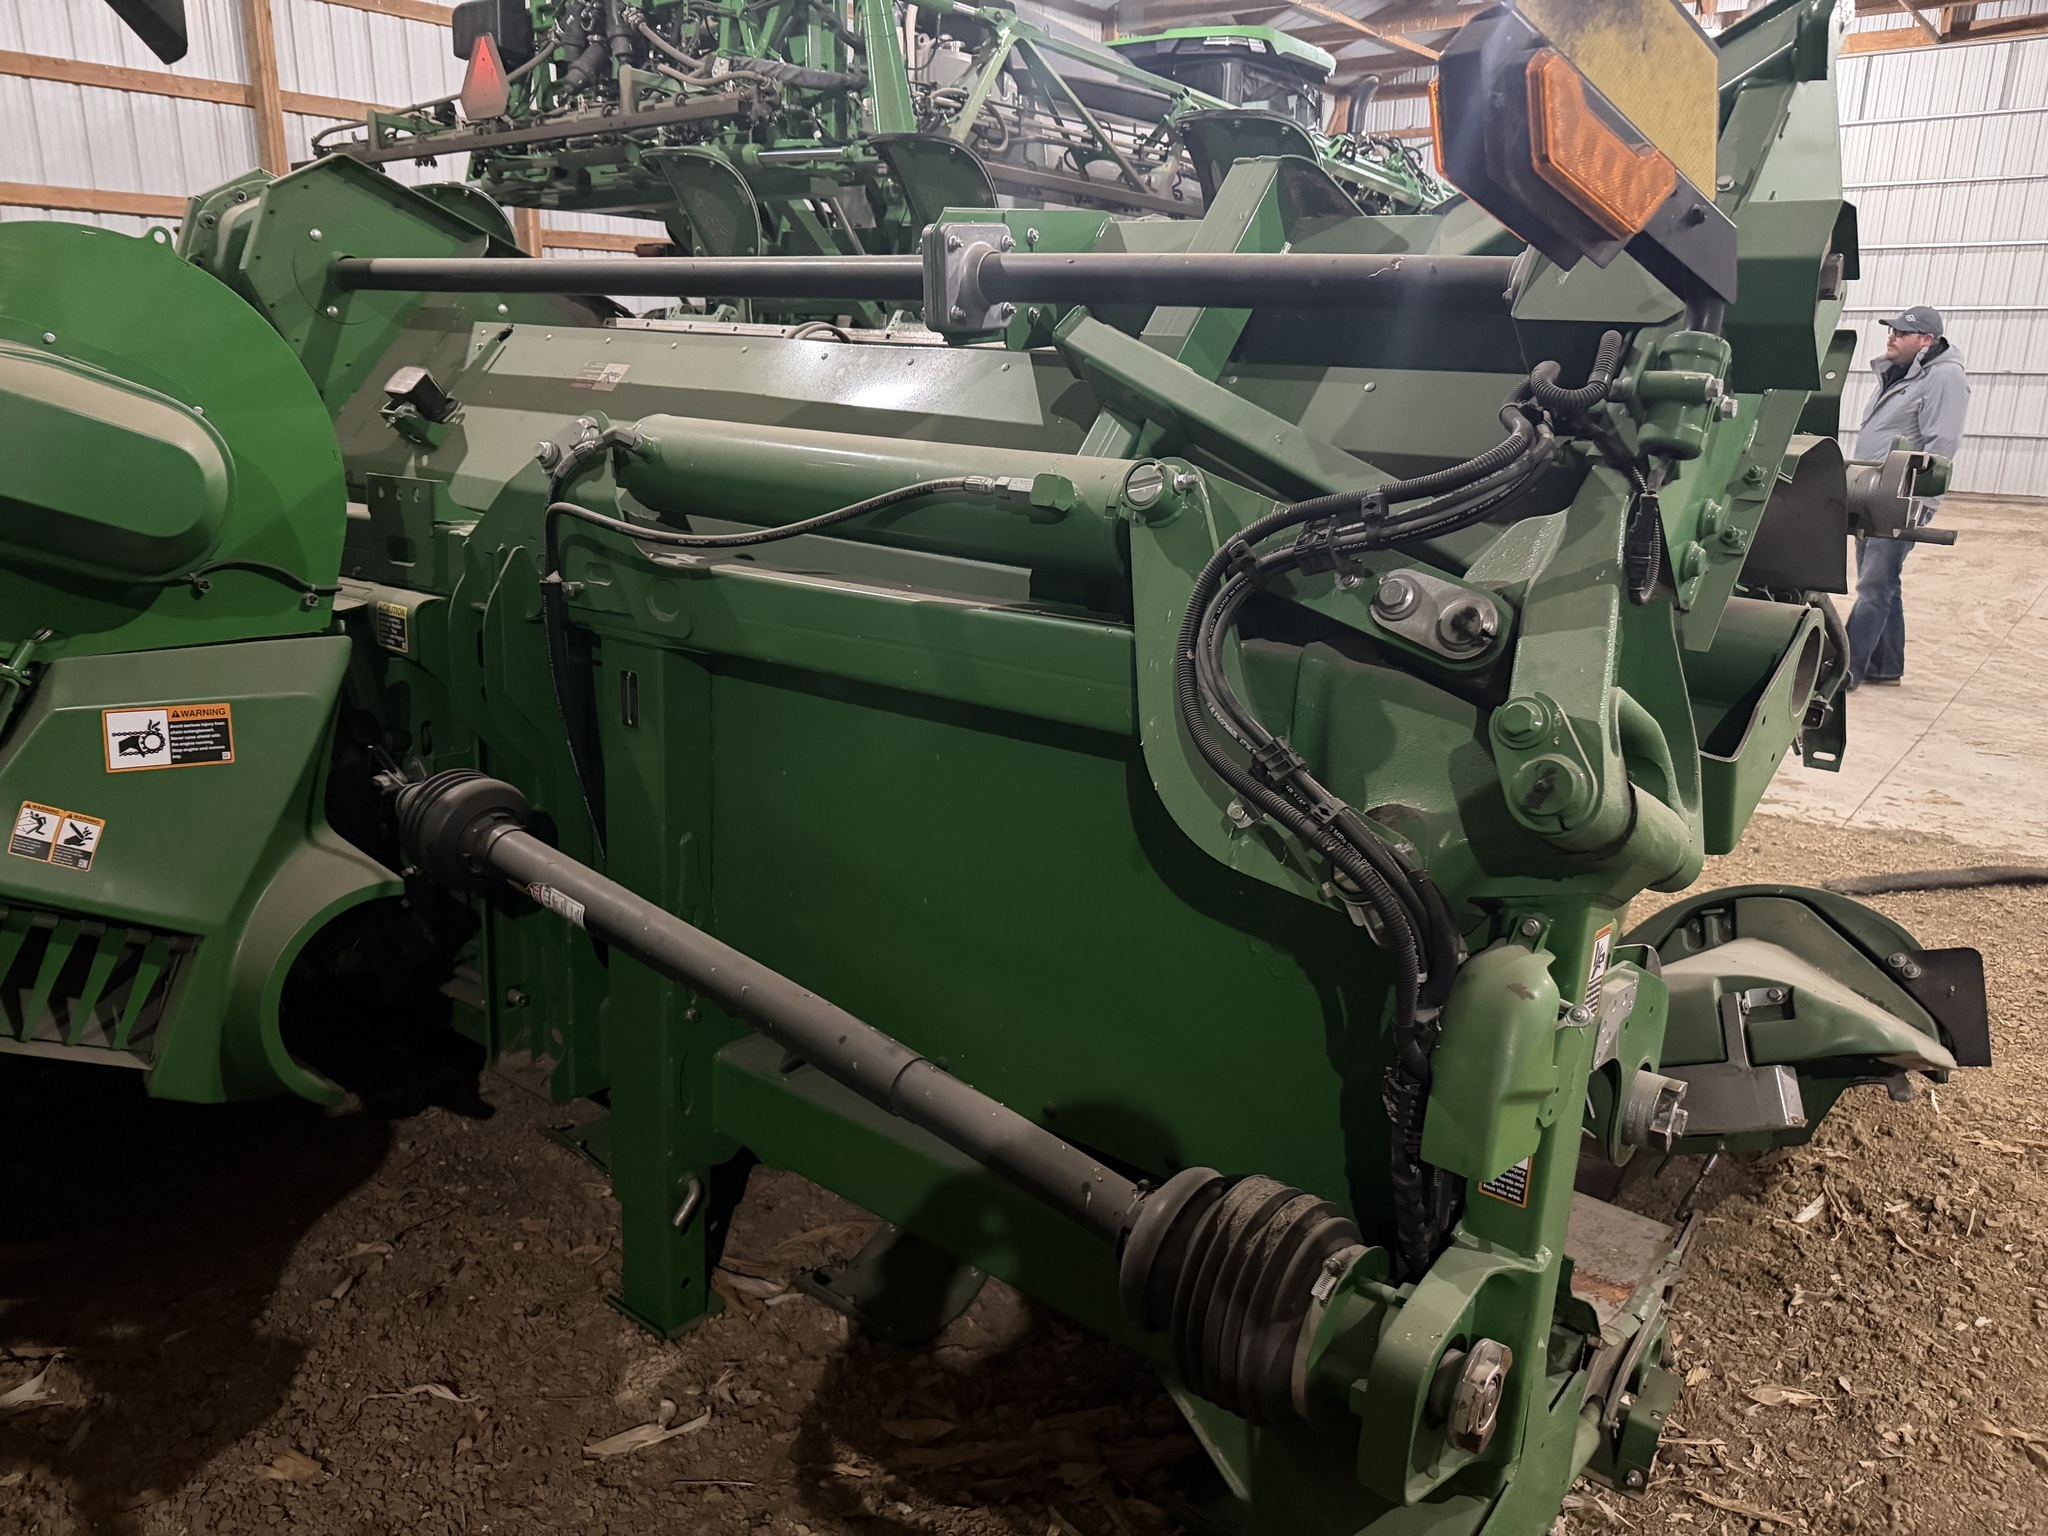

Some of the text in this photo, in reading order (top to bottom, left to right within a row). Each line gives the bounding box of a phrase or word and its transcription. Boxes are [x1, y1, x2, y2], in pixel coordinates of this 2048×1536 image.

[1216, 595, 1231, 614] MADE
[1229, 589, 1236, 597] IN
[180, 708, 226, 718] WARNING
[1333, 829, 1347, 844] MPa
[1497, 1188, 1507, 1196] this
[1506, 1186, 1521, 1195] away
